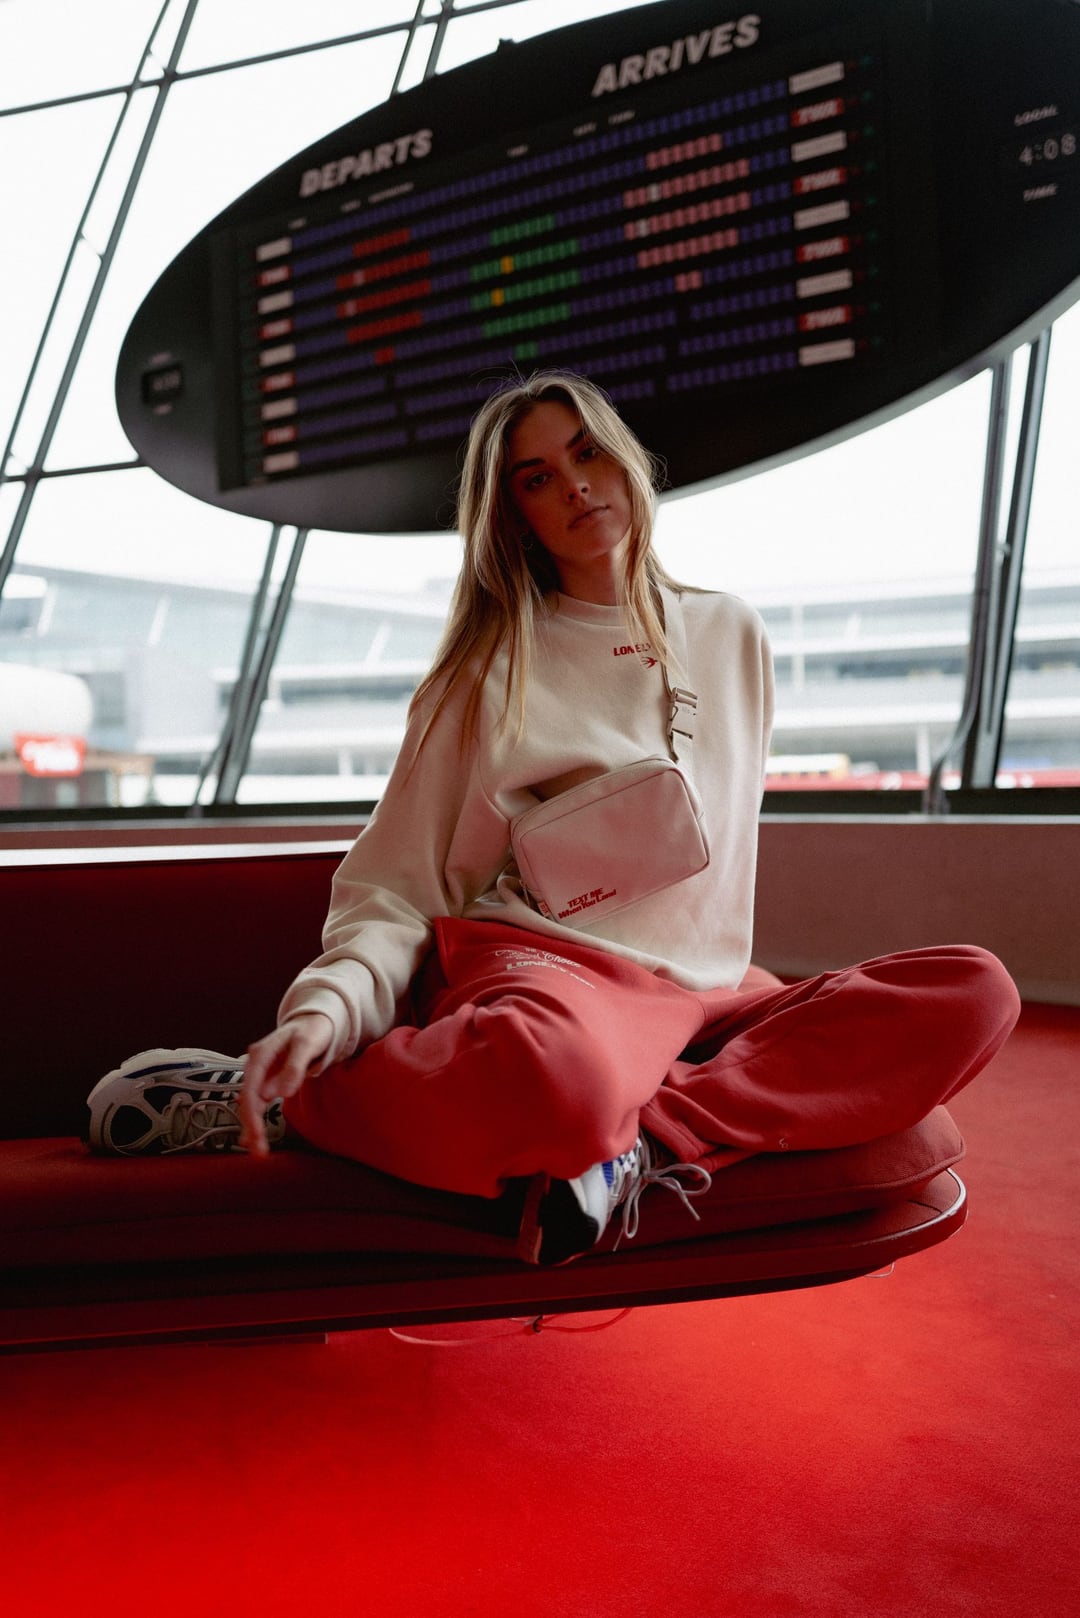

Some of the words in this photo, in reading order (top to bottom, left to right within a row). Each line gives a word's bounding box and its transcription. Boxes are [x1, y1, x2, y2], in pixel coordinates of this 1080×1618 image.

[591, 14, 760, 97] ARRIVES
[300, 129, 433, 198] DEPARTS
[1019, 133, 1077, 166] 4:08
[558, 905, 582, 919] When
[581, 899, 597, 910] You
[596, 888, 617, 904] Land
[567, 893, 589, 908] TEXT
[590, 887, 604, 898] ME
